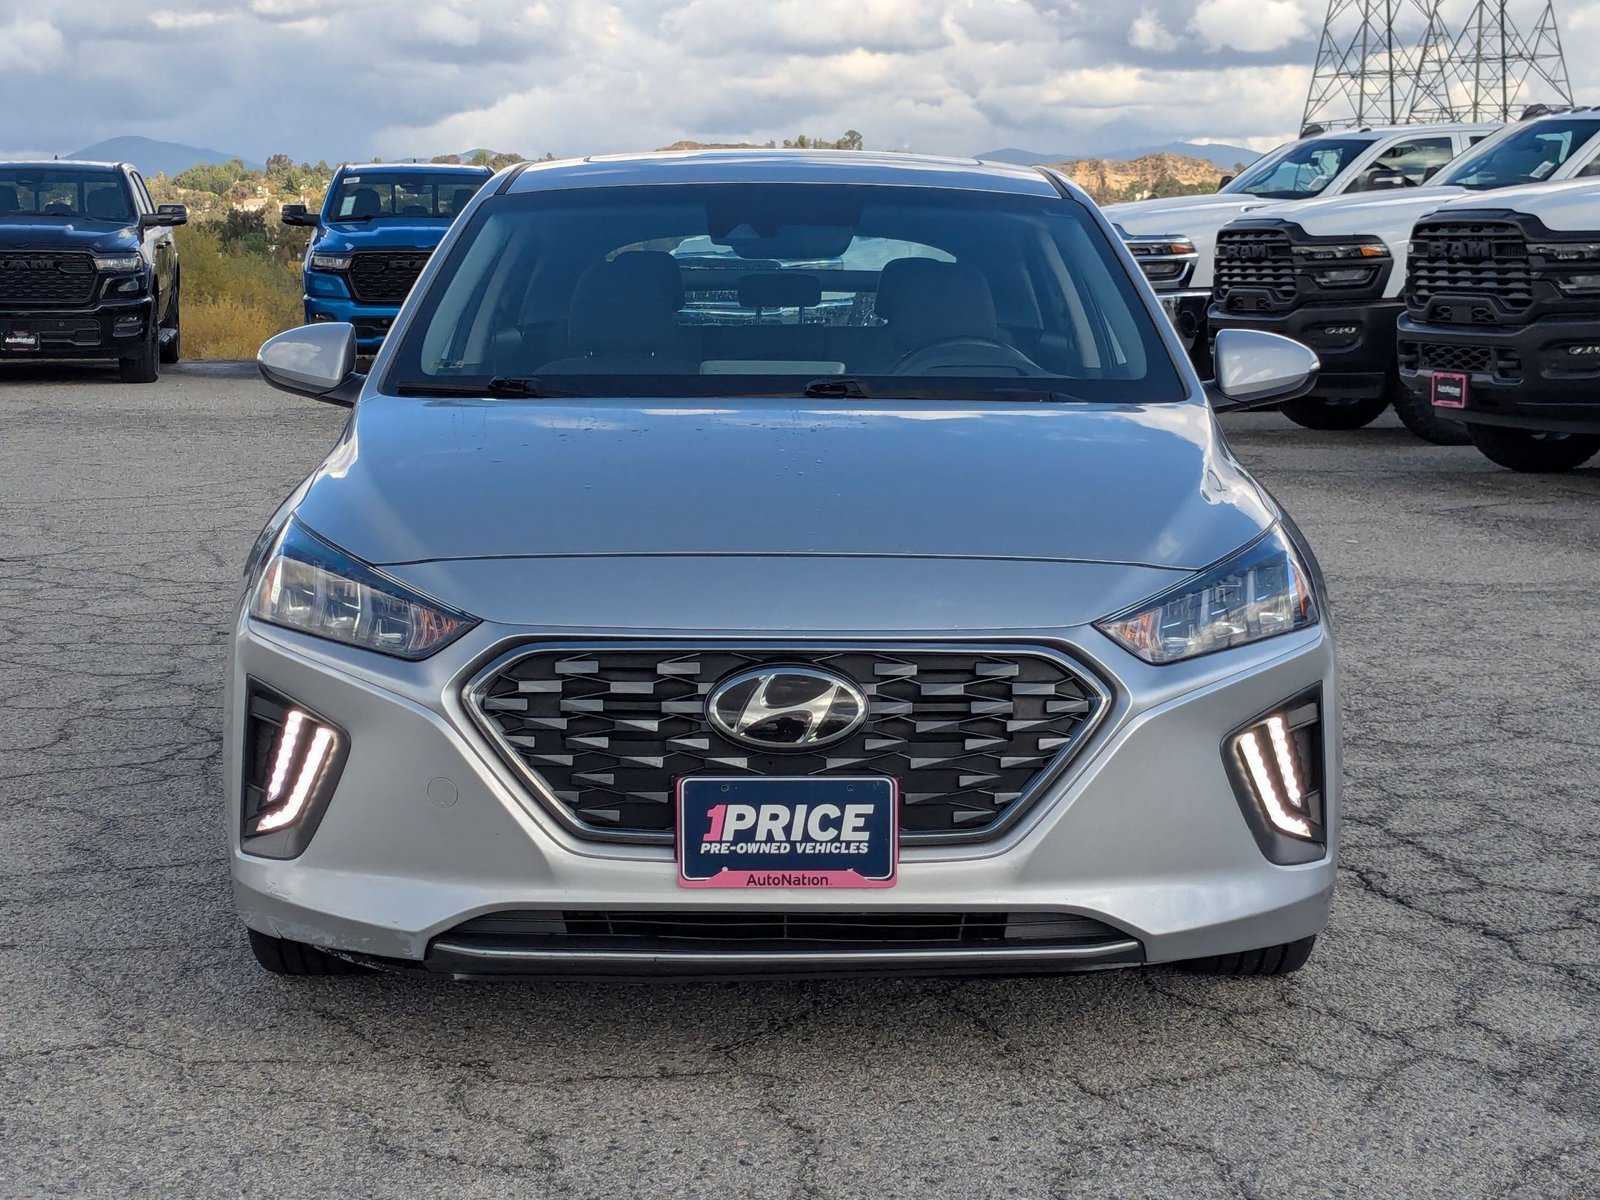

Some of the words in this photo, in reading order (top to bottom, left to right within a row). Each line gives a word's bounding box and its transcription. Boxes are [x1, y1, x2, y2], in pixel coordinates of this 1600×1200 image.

[1428, 241, 1491, 257] RAM
[700, 842, 791, 854] PRE-OWNED
[796, 842, 869, 854] VEHICLES
[746, 874, 829, 886] AutoNation
